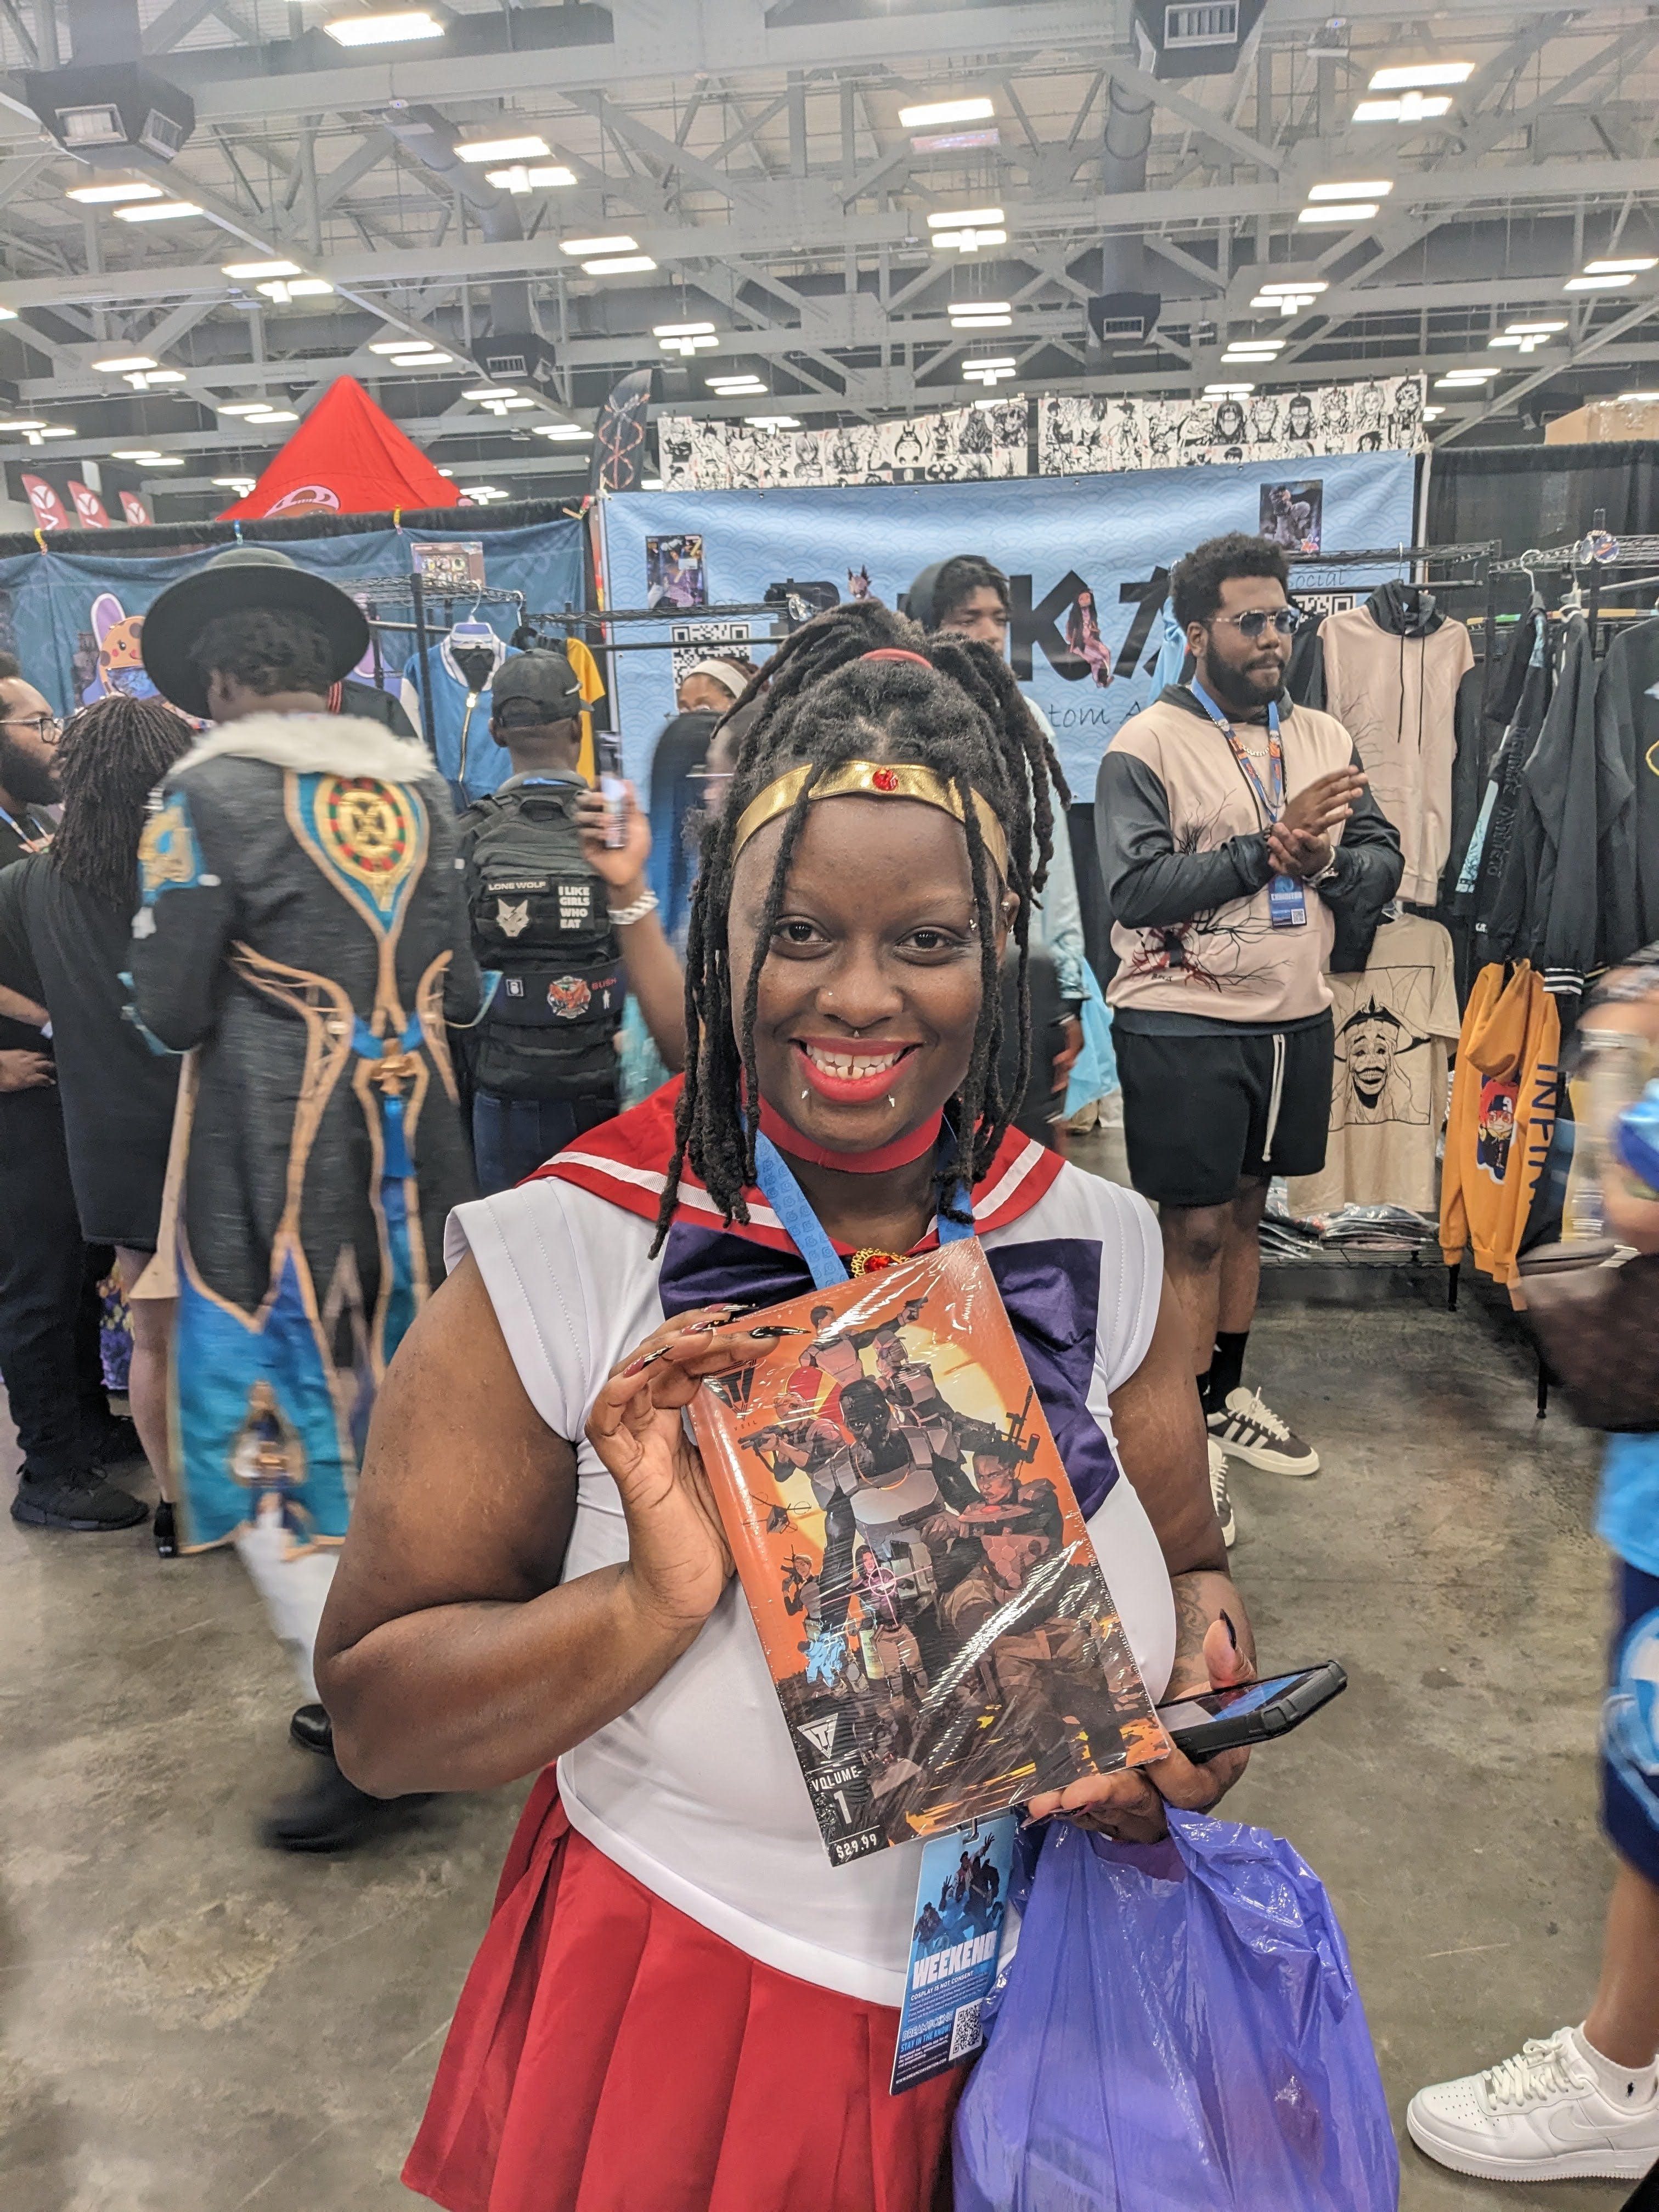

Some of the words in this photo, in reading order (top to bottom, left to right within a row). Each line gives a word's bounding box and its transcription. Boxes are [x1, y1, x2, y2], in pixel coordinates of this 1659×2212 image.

[1048, 704, 1110, 727] tom
[488, 882, 515, 891] LONE
[516, 881, 546, 889] WOLF
[558, 886, 563, 895] I
[565, 886, 590, 895] LIKE
[559, 897, 590, 906] GIRLS
[560, 908, 588, 917] WHO
[560, 919, 581, 929] EAT
[811, 1765, 859, 1792] VOLUME
[833, 1790, 852, 1825] 1
[836, 1833, 877, 1859] $29.99
[912, 1930, 997, 1990] WEEKEND
[911, 1988, 933, 2001] COSPLAY
[940, 1980, 951, 1989] NOT
[951, 1971, 974, 1984] CONSENT
[900, 2040, 914, 2052] STAY
[916, 2036, 922, 2046] IN
[923, 2032, 933, 2042] THE
